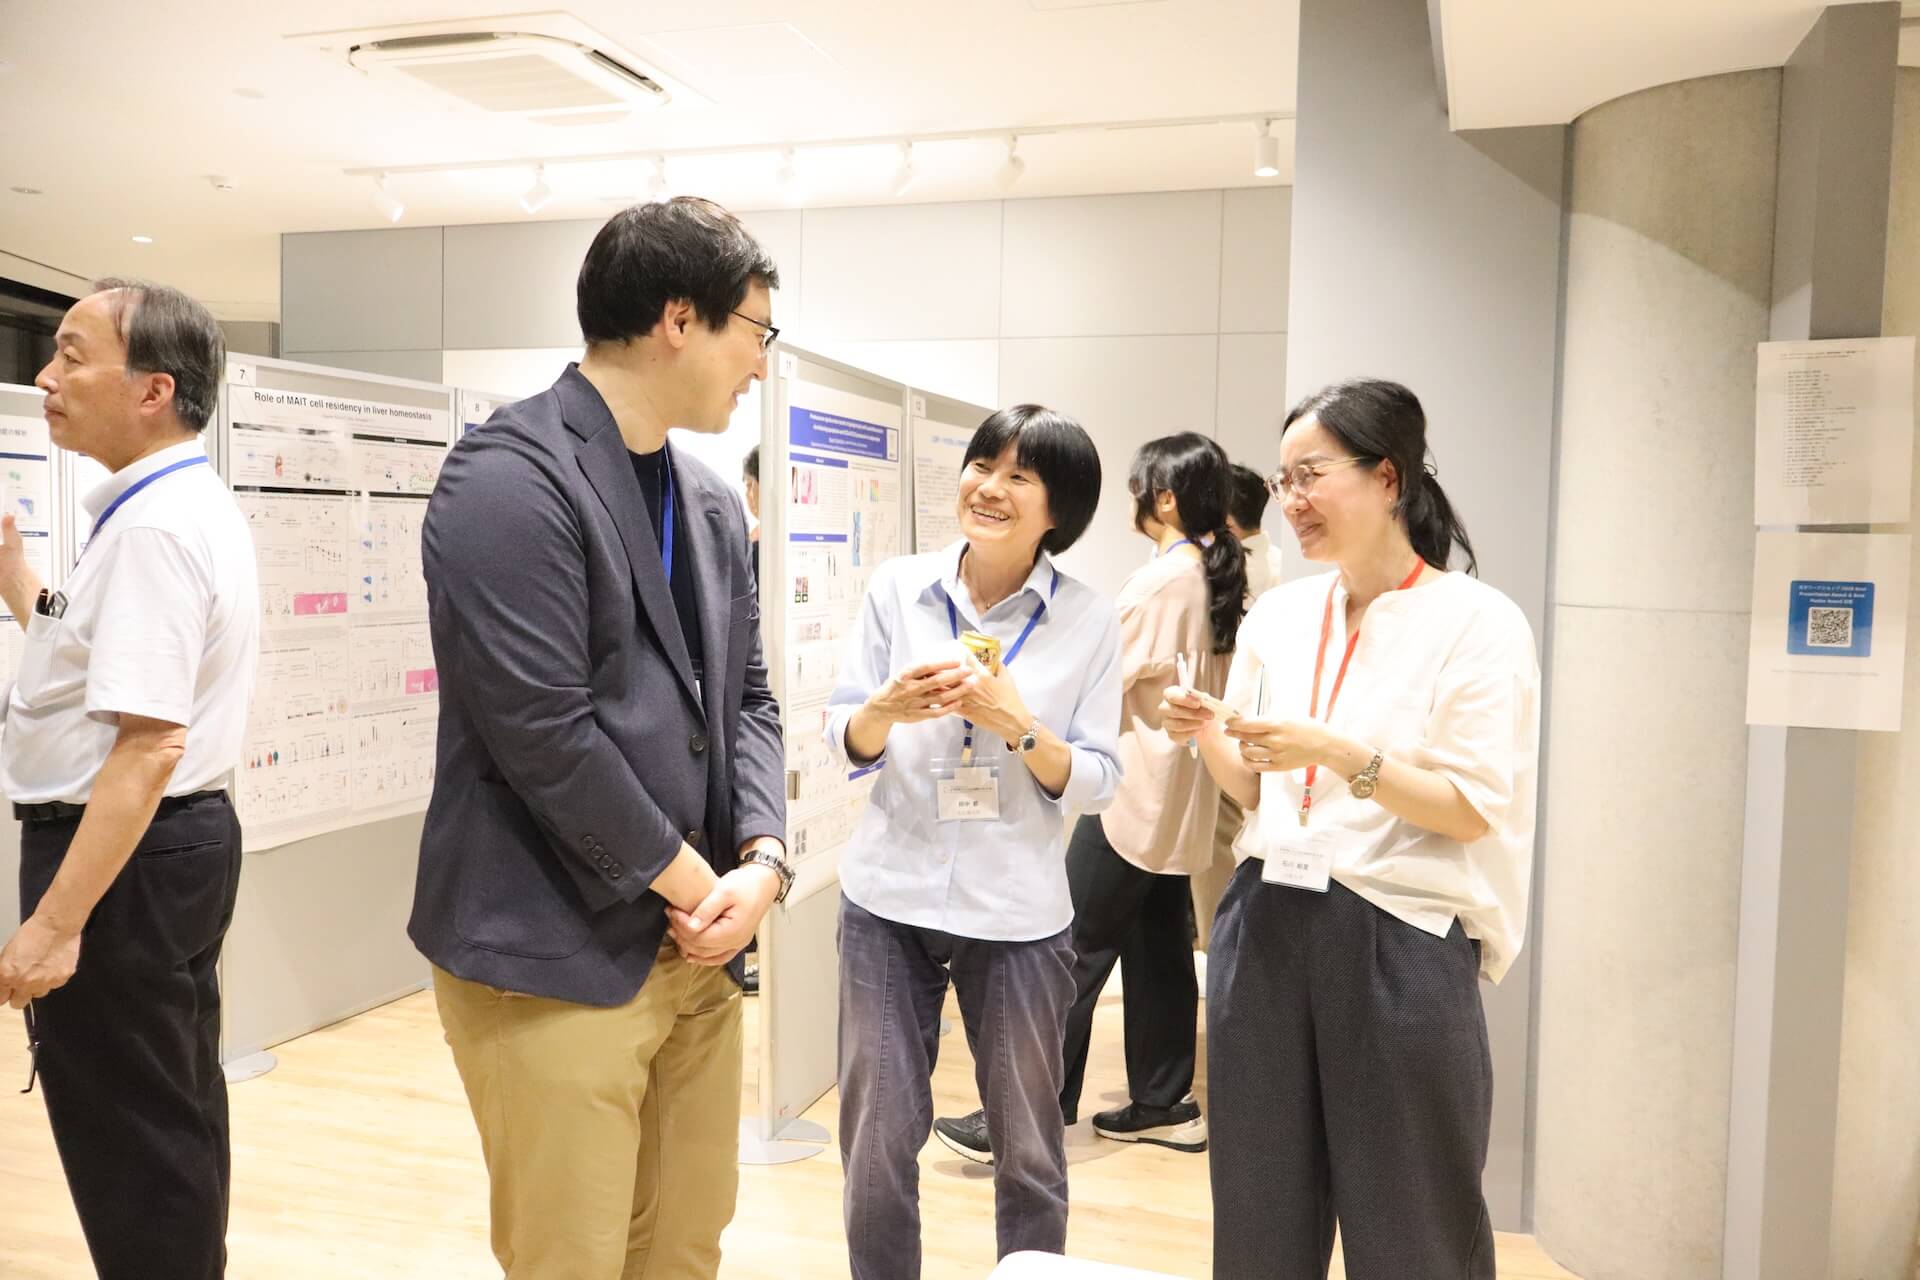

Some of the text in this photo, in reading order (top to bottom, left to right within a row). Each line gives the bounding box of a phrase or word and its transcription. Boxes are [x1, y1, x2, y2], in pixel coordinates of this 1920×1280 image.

[240, 368, 246, 380] 7
[254, 391, 432, 421] Role of MAIT cell residency in liver homeostasis
